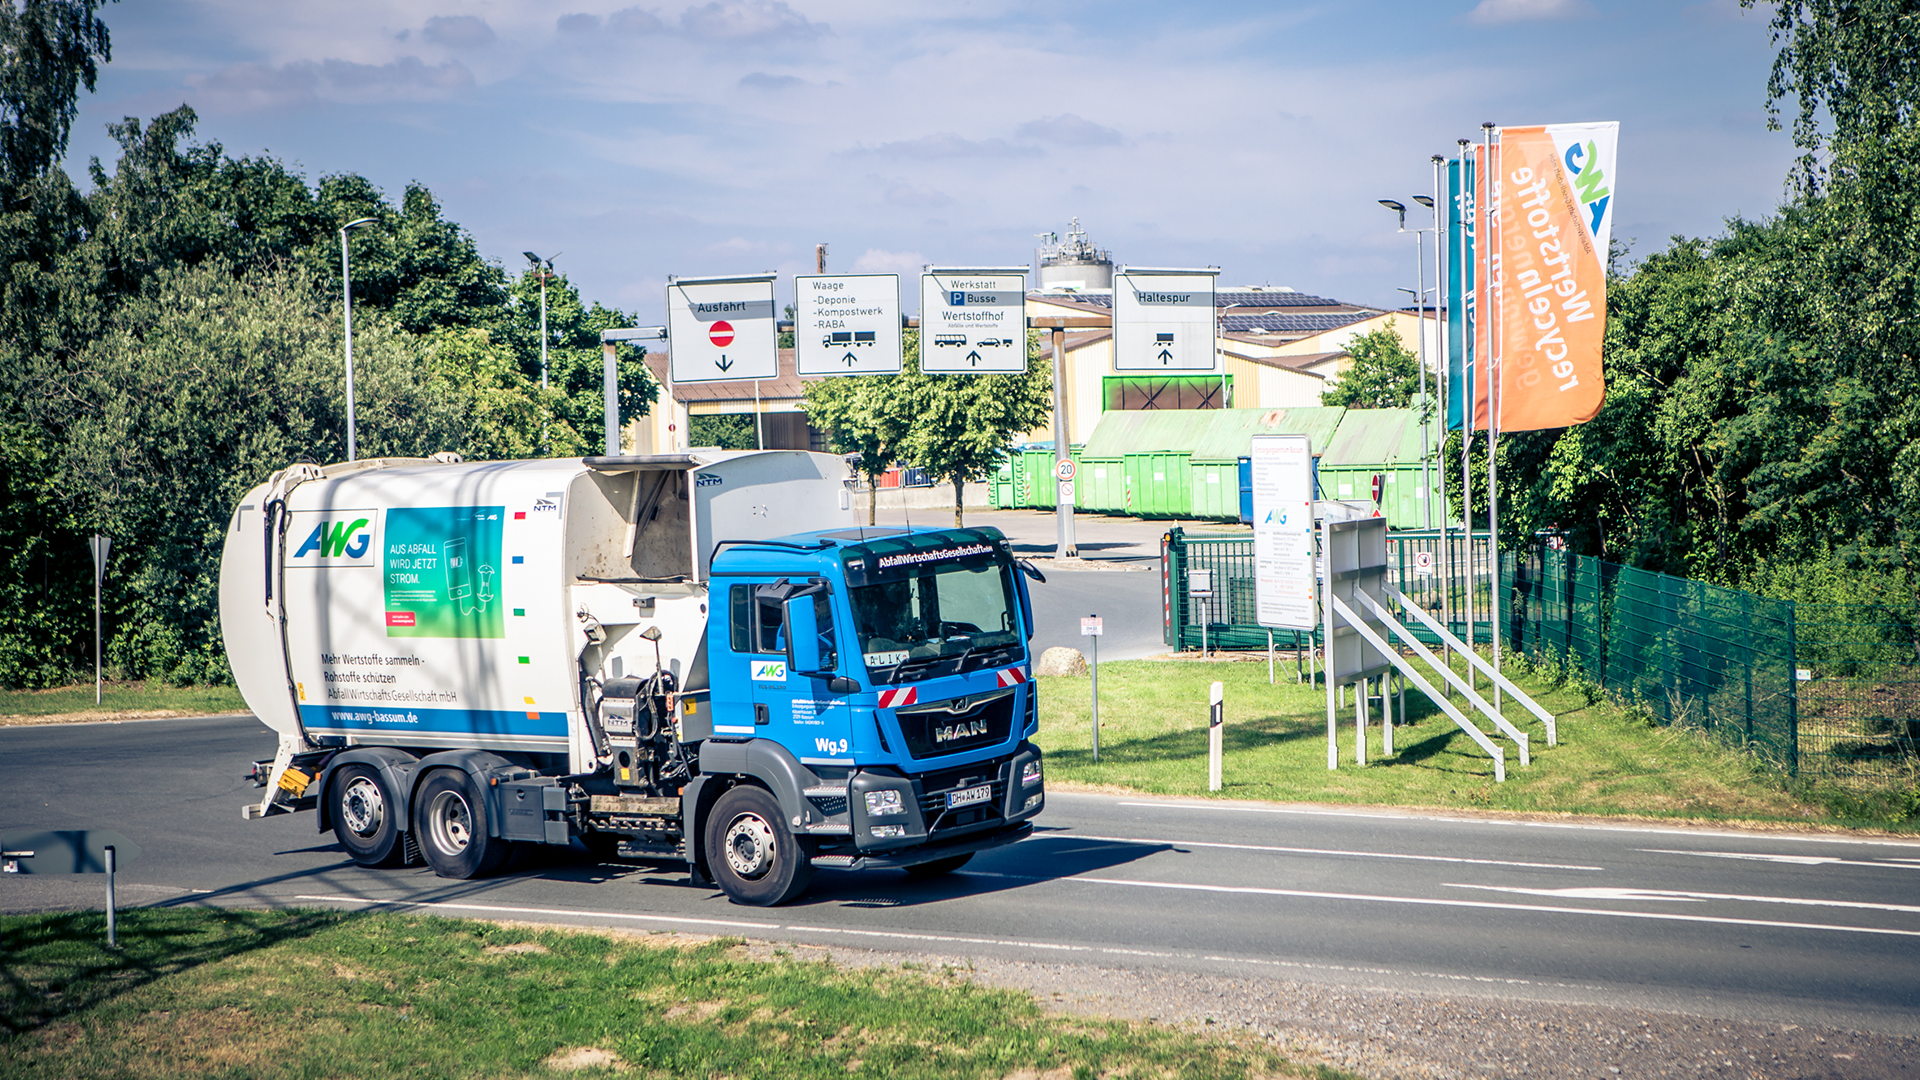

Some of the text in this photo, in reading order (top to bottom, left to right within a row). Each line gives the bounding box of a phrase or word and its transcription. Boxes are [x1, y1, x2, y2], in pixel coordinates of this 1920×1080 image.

[812, 281, 844, 292] Waage
[950, 280, 997, 289] Werkstatt
[813, 295, 856, 306] -Deponie
[953, 292, 996, 304] P Busse
[1138, 292, 1191, 305] Haltespur
[697, 302, 746, 313] Ausfahrt
[813, 306, 884, 318] -Kompostwerk
[942, 311, 1005, 321] Wertstoffhof
[813, 320, 845, 329] -RABA
[1060, 464, 1073, 474] 20
[697, 477, 723, 487] NTM
[533, 504, 557, 512] NTM
[1264, 507, 1288, 525] AWG
[293, 518, 370, 559] AWG
[390, 544, 437, 554] AUS ABFALL
[390, 558, 437, 569] WIRD JETZT
[390, 573, 421, 584] STROM.
[321, 653, 341, 665] Mehr
[342, 654, 383, 666] Wertstoffe
[385, 654, 420, 666] sammeln
[756, 664, 784, 678] AWG
[324, 671, 397, 684] Rohstoffe schützen
[439, 691, 457, 702] mbH
[331, 710, 419, 725] www.awg-bassum.de
[607, 719, 629, 727] NTM
[935, 719, 988, 743] MAN
[815, 737, 848, 756] Wg.9
[952, 792, 962, 804] DH
[976, 787, 990, 799] 179
